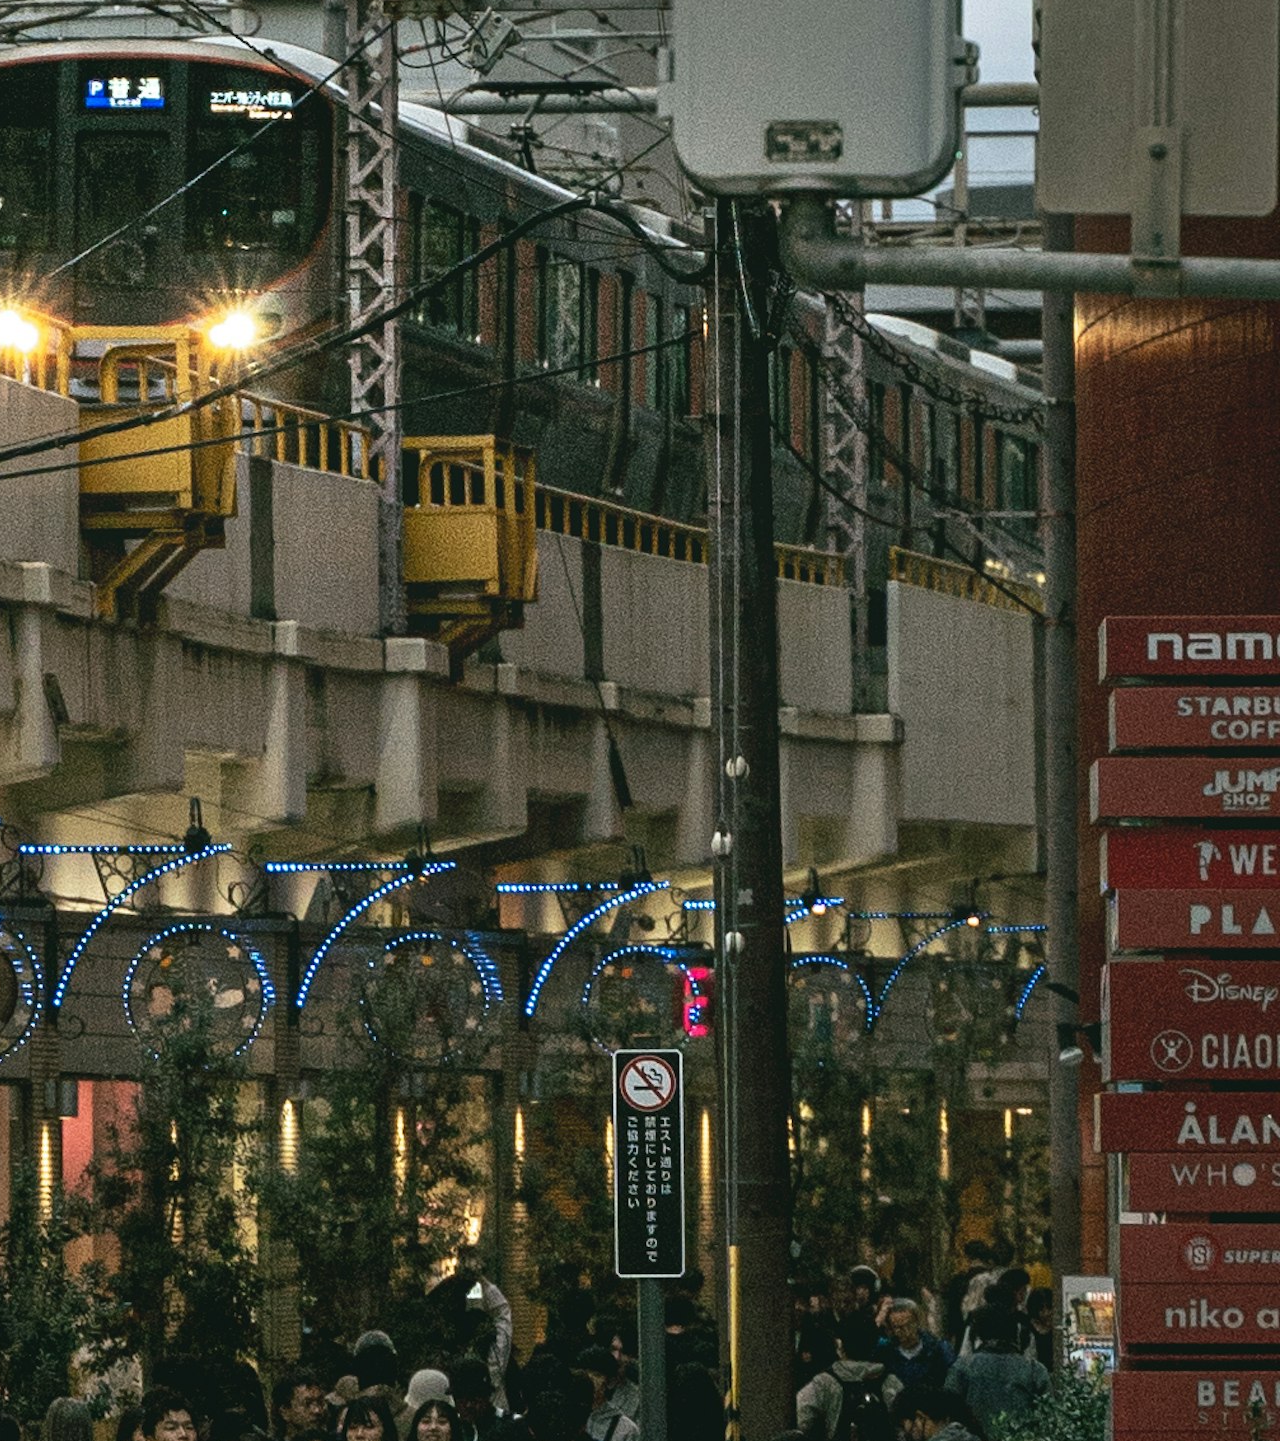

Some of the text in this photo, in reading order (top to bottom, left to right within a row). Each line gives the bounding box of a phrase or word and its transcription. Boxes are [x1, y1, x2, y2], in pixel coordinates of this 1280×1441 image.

[108, 77, 161, 99] 普通
[1147, 632, 1280, 661] nam
[1222, 793, 1270, 806] SHOP
[1229, 844, 1278, 876] WE
[1190, 904, 1276, 935] PLA
[1201, 1033, 1280, 1069] CIAO
[627, 1116, 640, 1209] ご協力ください
[659, 1116, 672, 1196] エスト通りは
[644, 1116, 658, 1262] 禁煙にしておりますので
[1164, 1298, 1244, 1329] niko
[1197, 1380, 1280, 1407] BEA
